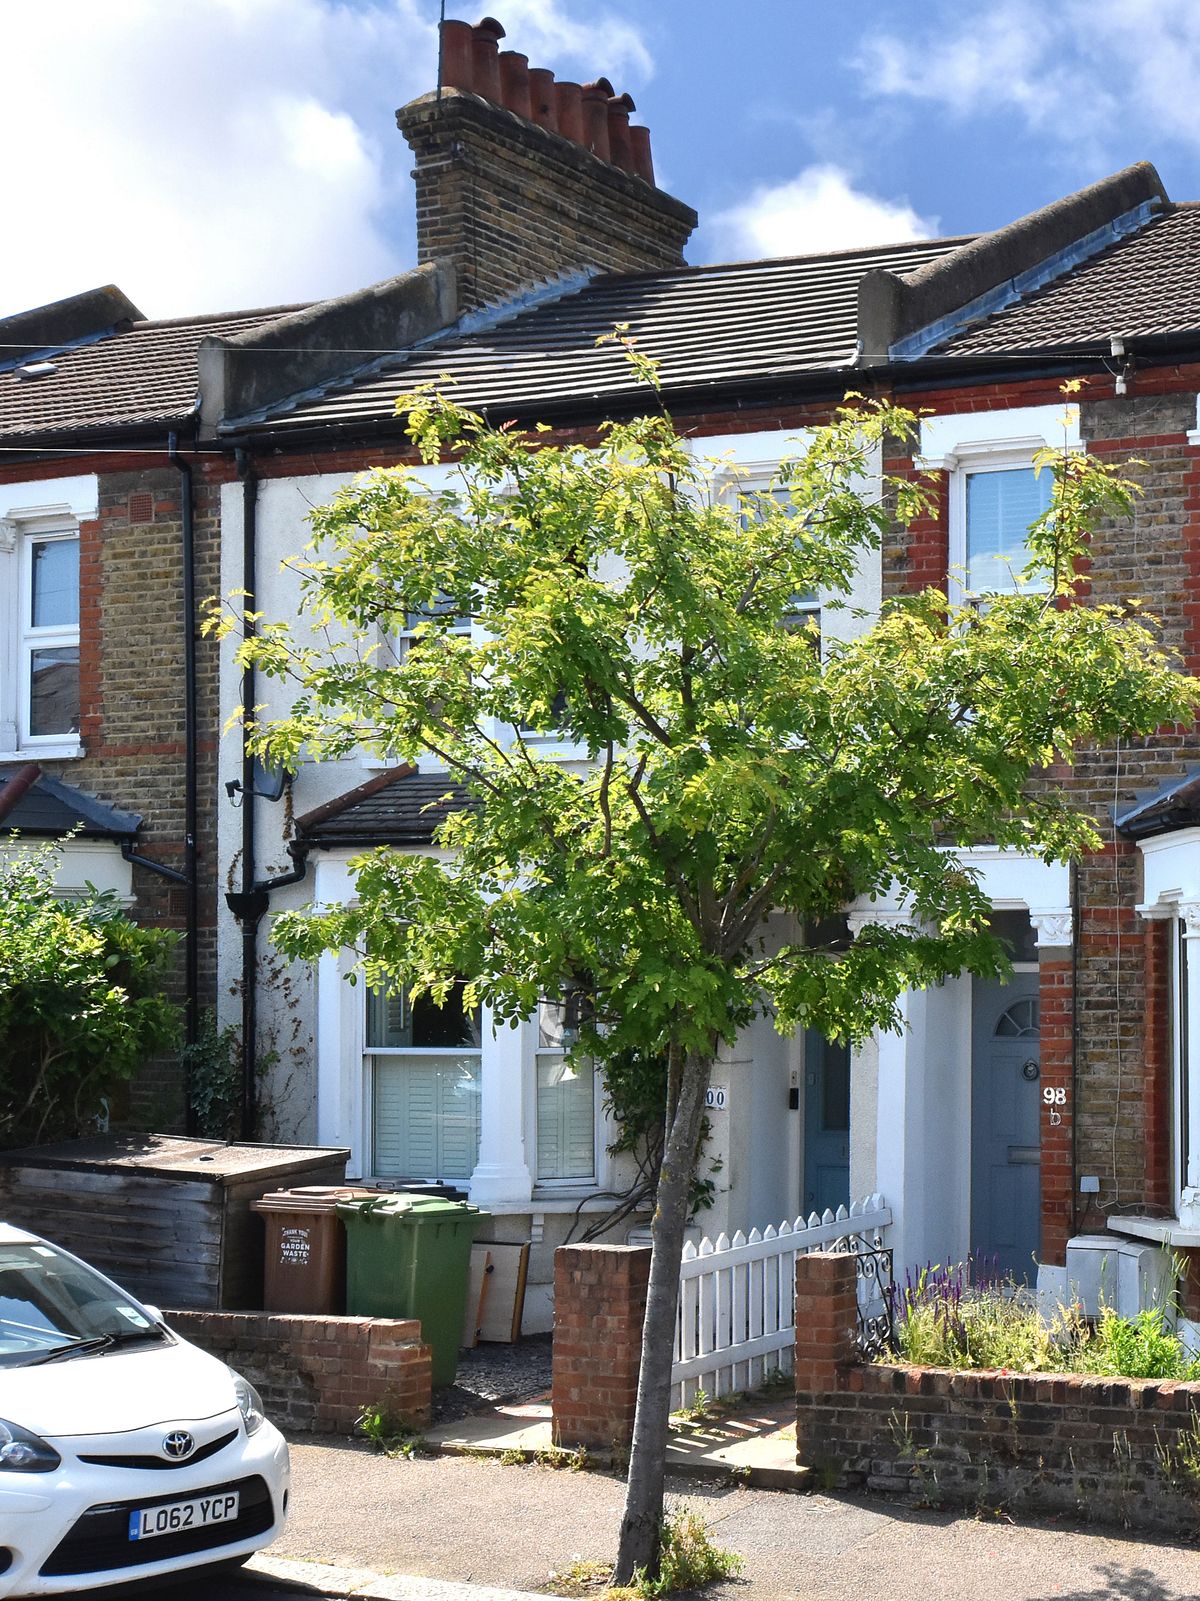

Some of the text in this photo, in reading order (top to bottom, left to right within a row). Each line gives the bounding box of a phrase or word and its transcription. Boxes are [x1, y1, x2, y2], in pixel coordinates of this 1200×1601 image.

[706, 1090, 724, 1105] 00
[1043, 1087, 1067, 1105] 98
[1050, 1107, 1062, 1126] b
[281, 1243, 310, 1251] GARDEN
[142, 1496, 236, 1535] LO62 YCP
